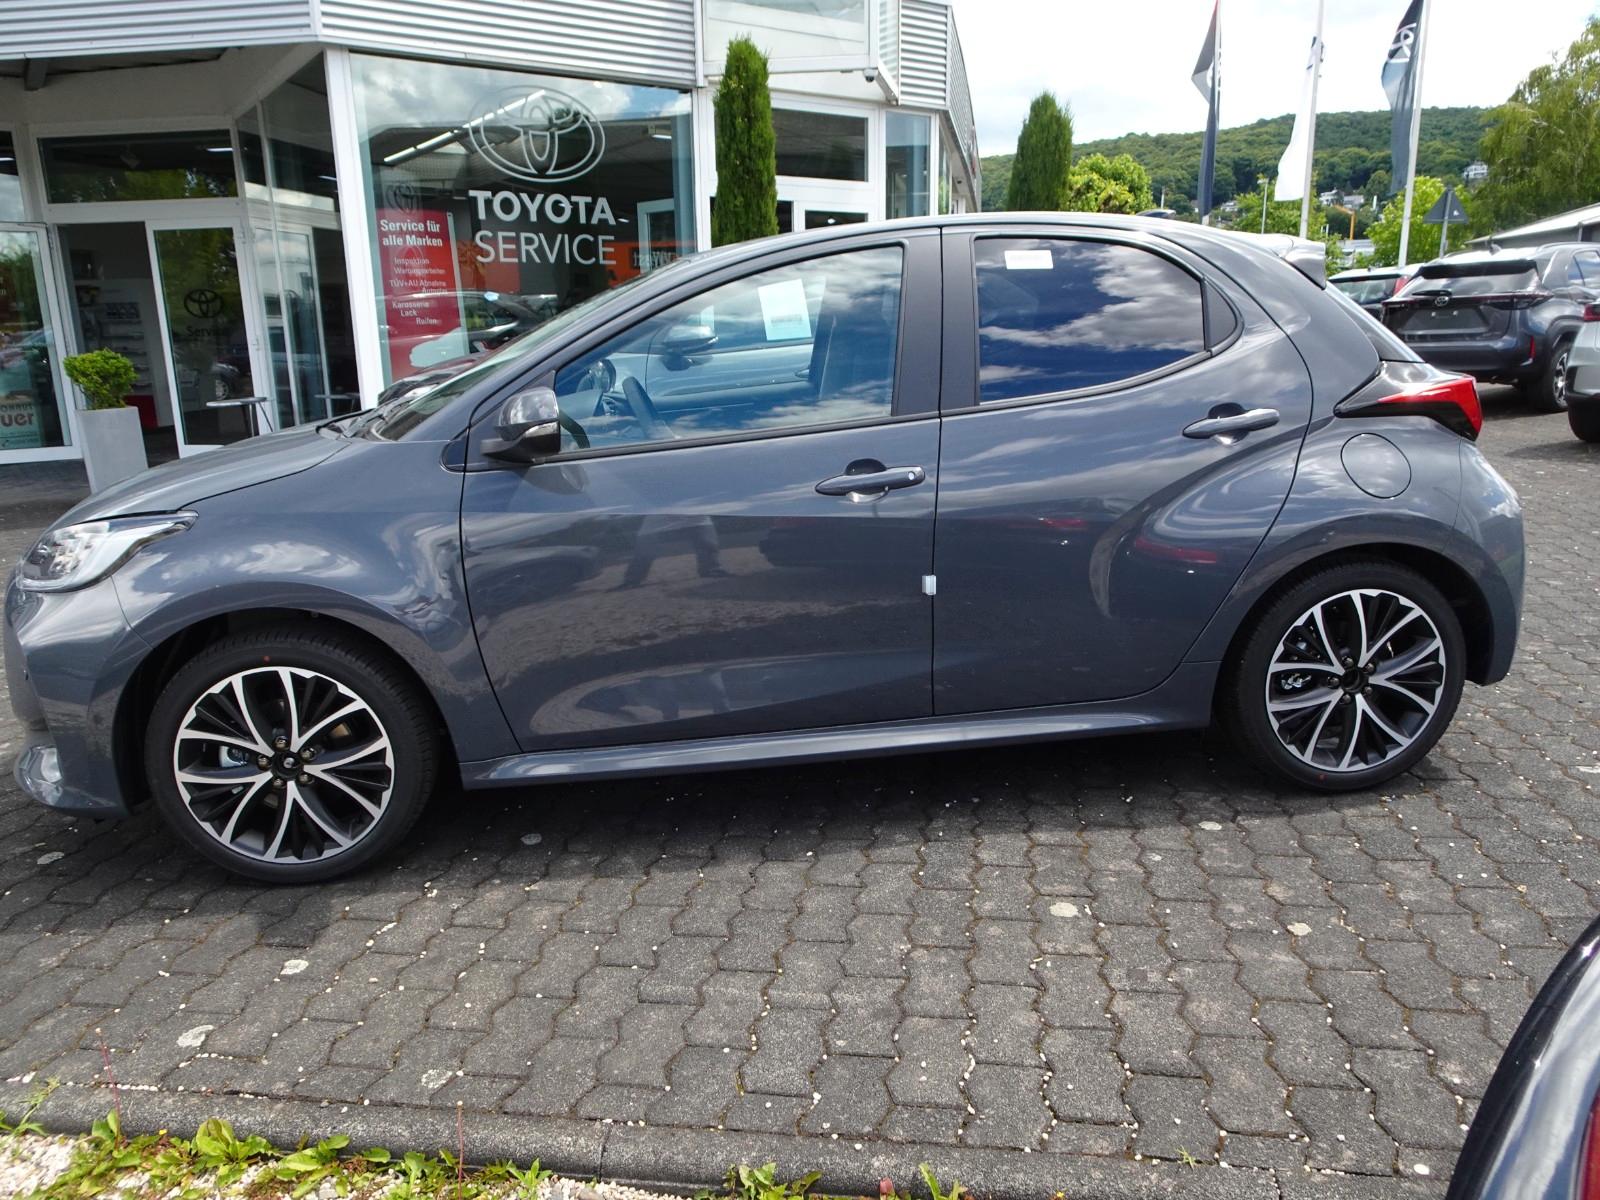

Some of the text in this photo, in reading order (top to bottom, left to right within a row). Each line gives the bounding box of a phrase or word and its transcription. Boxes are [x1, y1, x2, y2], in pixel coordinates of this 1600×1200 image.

[468, 190, 616, 225] TOYOTA
[380, 219, 440, 232] Service für
[382, 234, 443, 247] alle Marken
[474, 230, 616, 265] SERVICE
[394, 256, 430, 268] Inspektion
[400, 309, 418, 318] Lack
